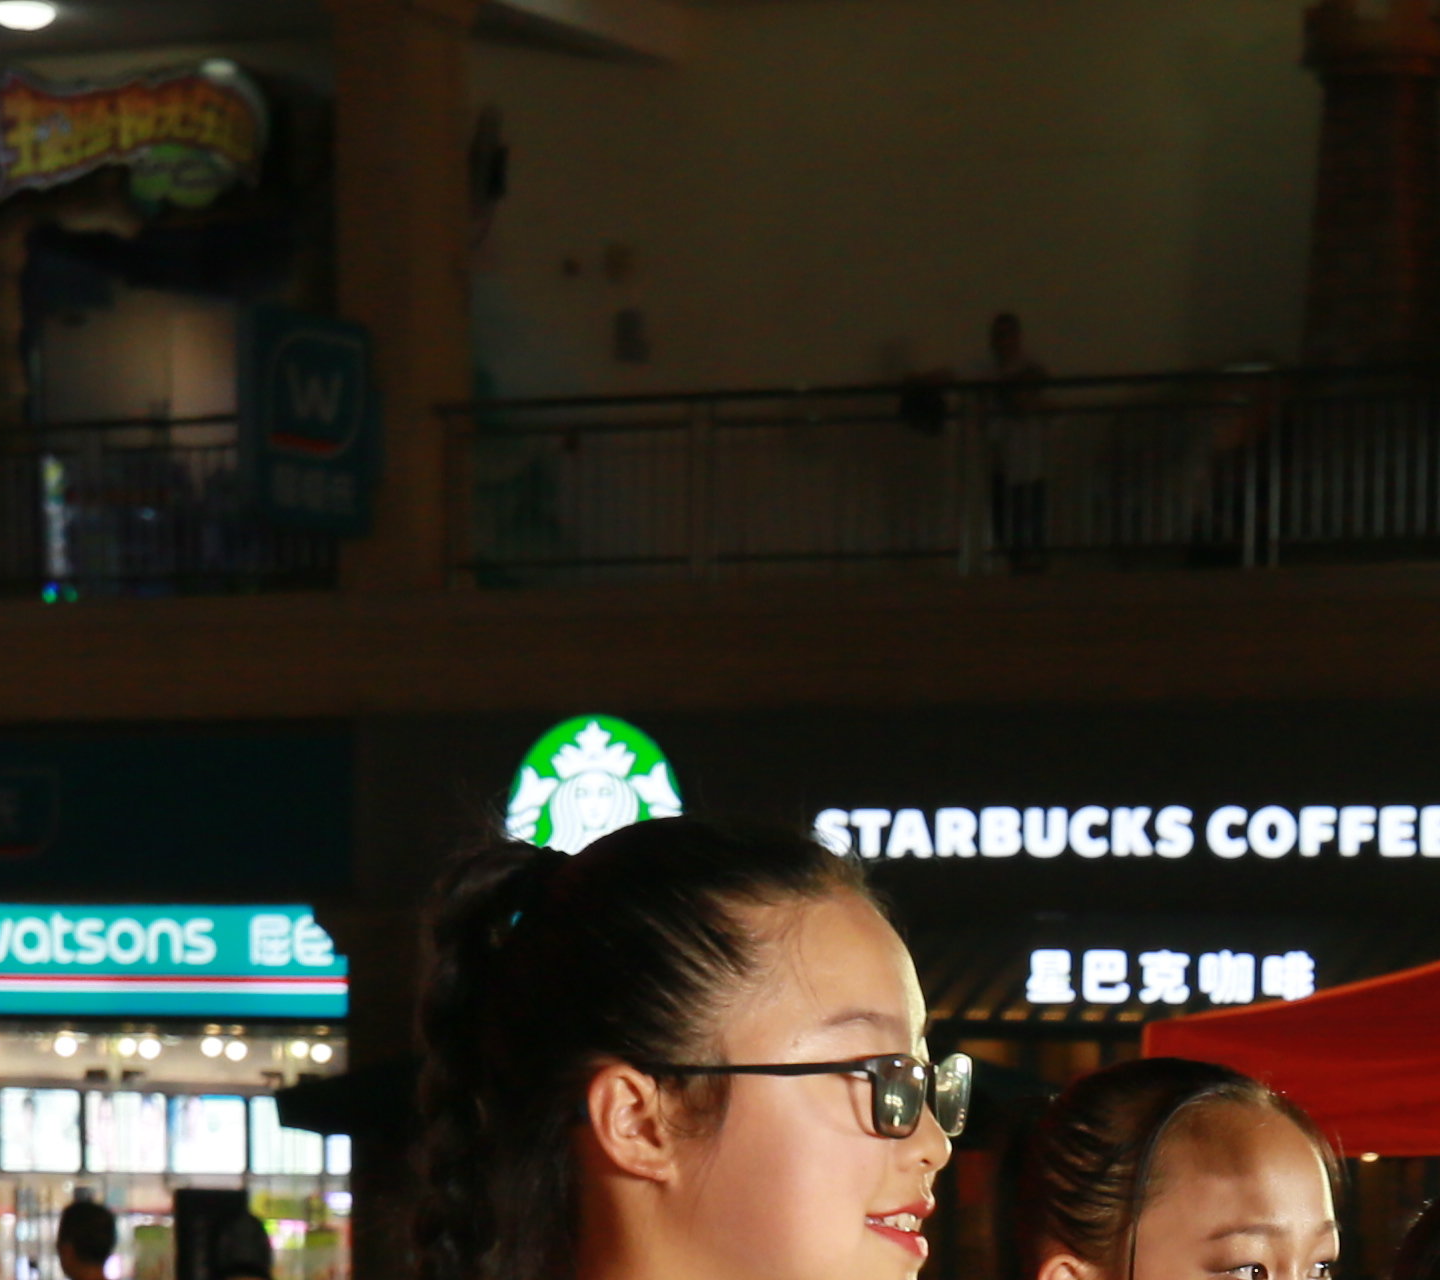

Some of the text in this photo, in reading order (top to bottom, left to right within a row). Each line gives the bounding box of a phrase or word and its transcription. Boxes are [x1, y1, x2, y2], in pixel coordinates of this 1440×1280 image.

[814, 805, 1194, 859] STARBUCKS
[248, 911, 337, 967] 屈臣
[1025, 948, 1316, 1005] 星巴克咖啡
